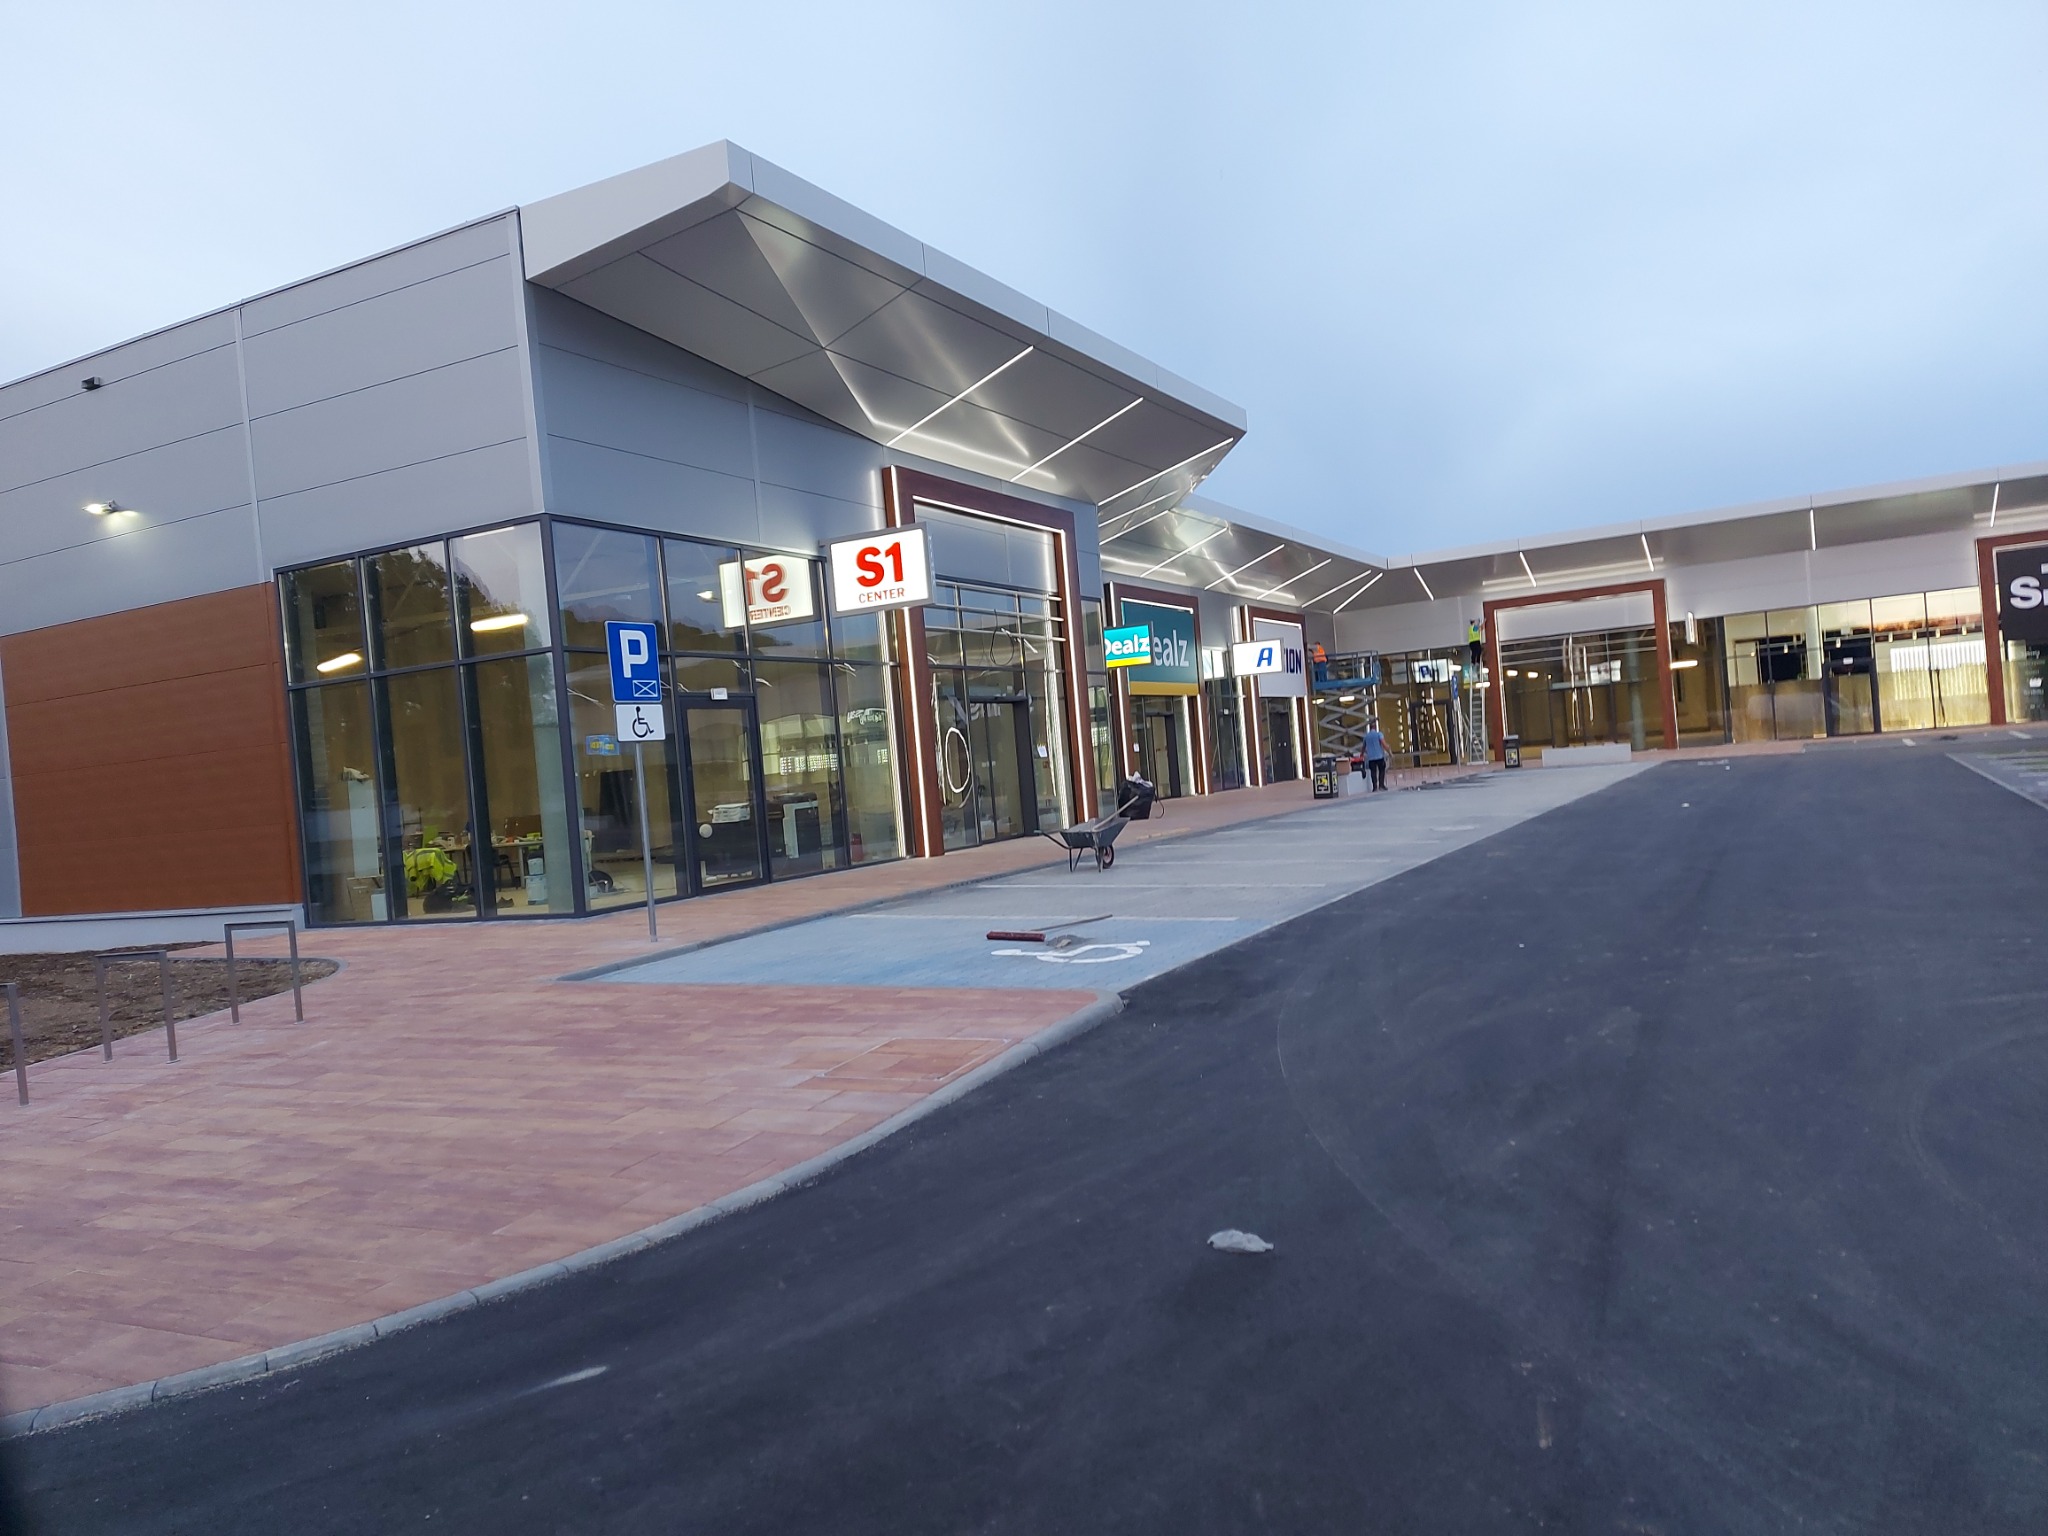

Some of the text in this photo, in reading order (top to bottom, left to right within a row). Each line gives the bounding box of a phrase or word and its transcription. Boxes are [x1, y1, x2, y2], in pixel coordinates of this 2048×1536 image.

[856, 542, 904, 587] S1
[859, 587, 905, 604] CENTER
[2010, 575, 2048, 609] S
[619, 629, 649, 678] P
[1153, 629, 1190, 667] ealz
[1256, 647, 1273, 668] A
[1284, 647, 1302, 674] ION
